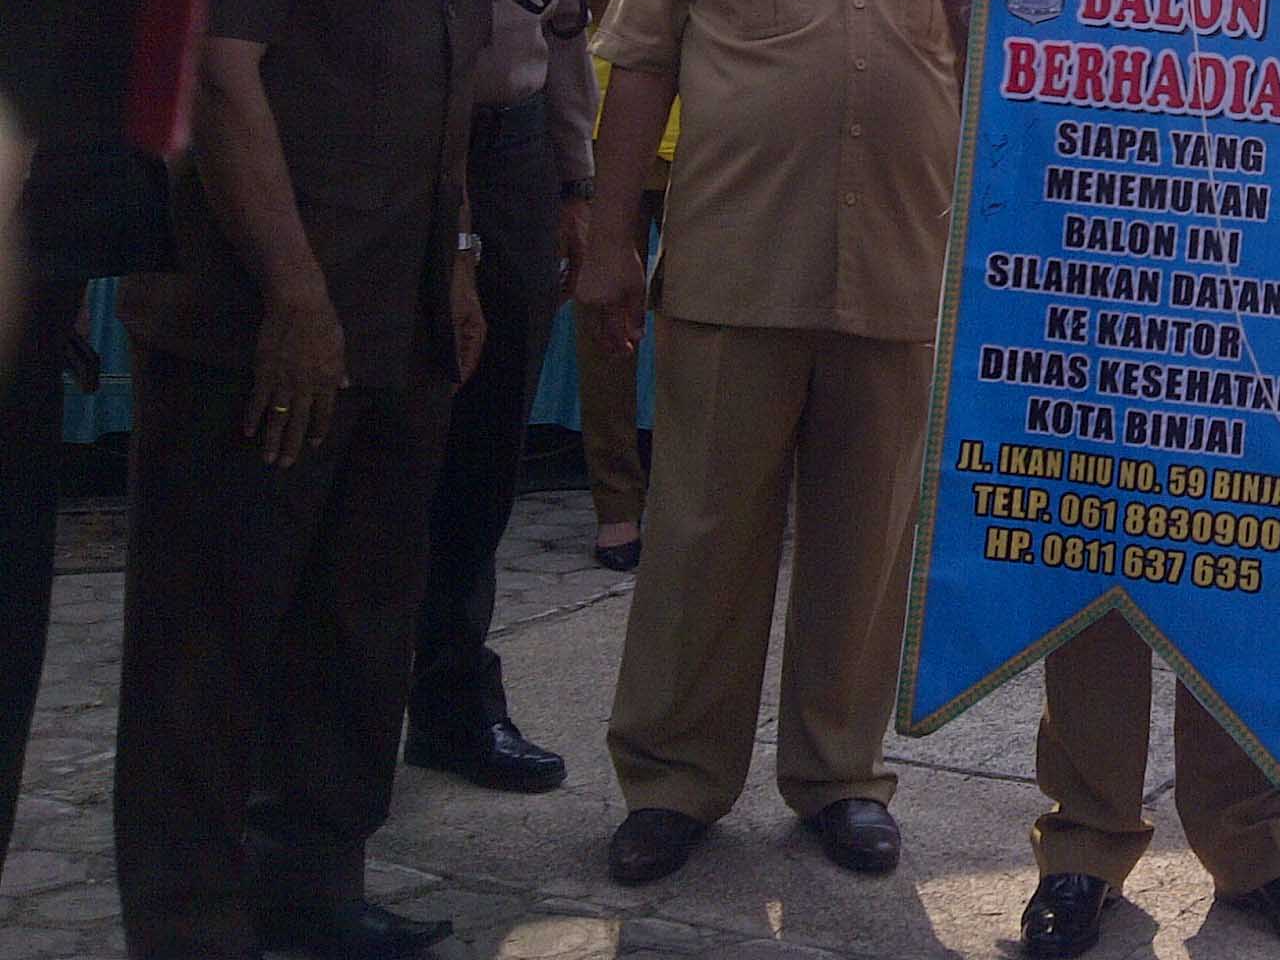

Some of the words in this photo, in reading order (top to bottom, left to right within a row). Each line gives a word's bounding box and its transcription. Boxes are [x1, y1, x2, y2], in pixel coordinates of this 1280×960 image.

[1055, 120, 1160, 163] SIAPA
[1171, 131, 1265, 174] YANG
[1045, 167, 1269, 220] MENEMUKAN
[1064, 215, 1175, 258] BALON
[1187, 227, 1241, 265] INI
[986, 253, 1160, 306] SILAHKAN
[1047, 304, 1088, 342] KE
[1097, 313, 1242, 360] KANTOR
[979, 345, 1090, 390] DINAS
[1026, 397, 1115, 441] KOTA
[1125, 410, 1245, 457] BINJAI
[957, 441, 991, 472] JL.
[999, 446, 1062, 479] IKAN
[1068, 451, 1112, 486] HIU
[1119, 457, 1160, 492] NO.
[1169, 463, 1206, 497] 59
[973, 484, 1050, 522] TELP.
[1060, 493, 1116, 531] 061
[984, 529, 1032, 562] HP.
[1042, 535, 1114, 575] 0811
[1124, 543, 1184, 584] 637
[1192, 553, 1262, 594] 635
